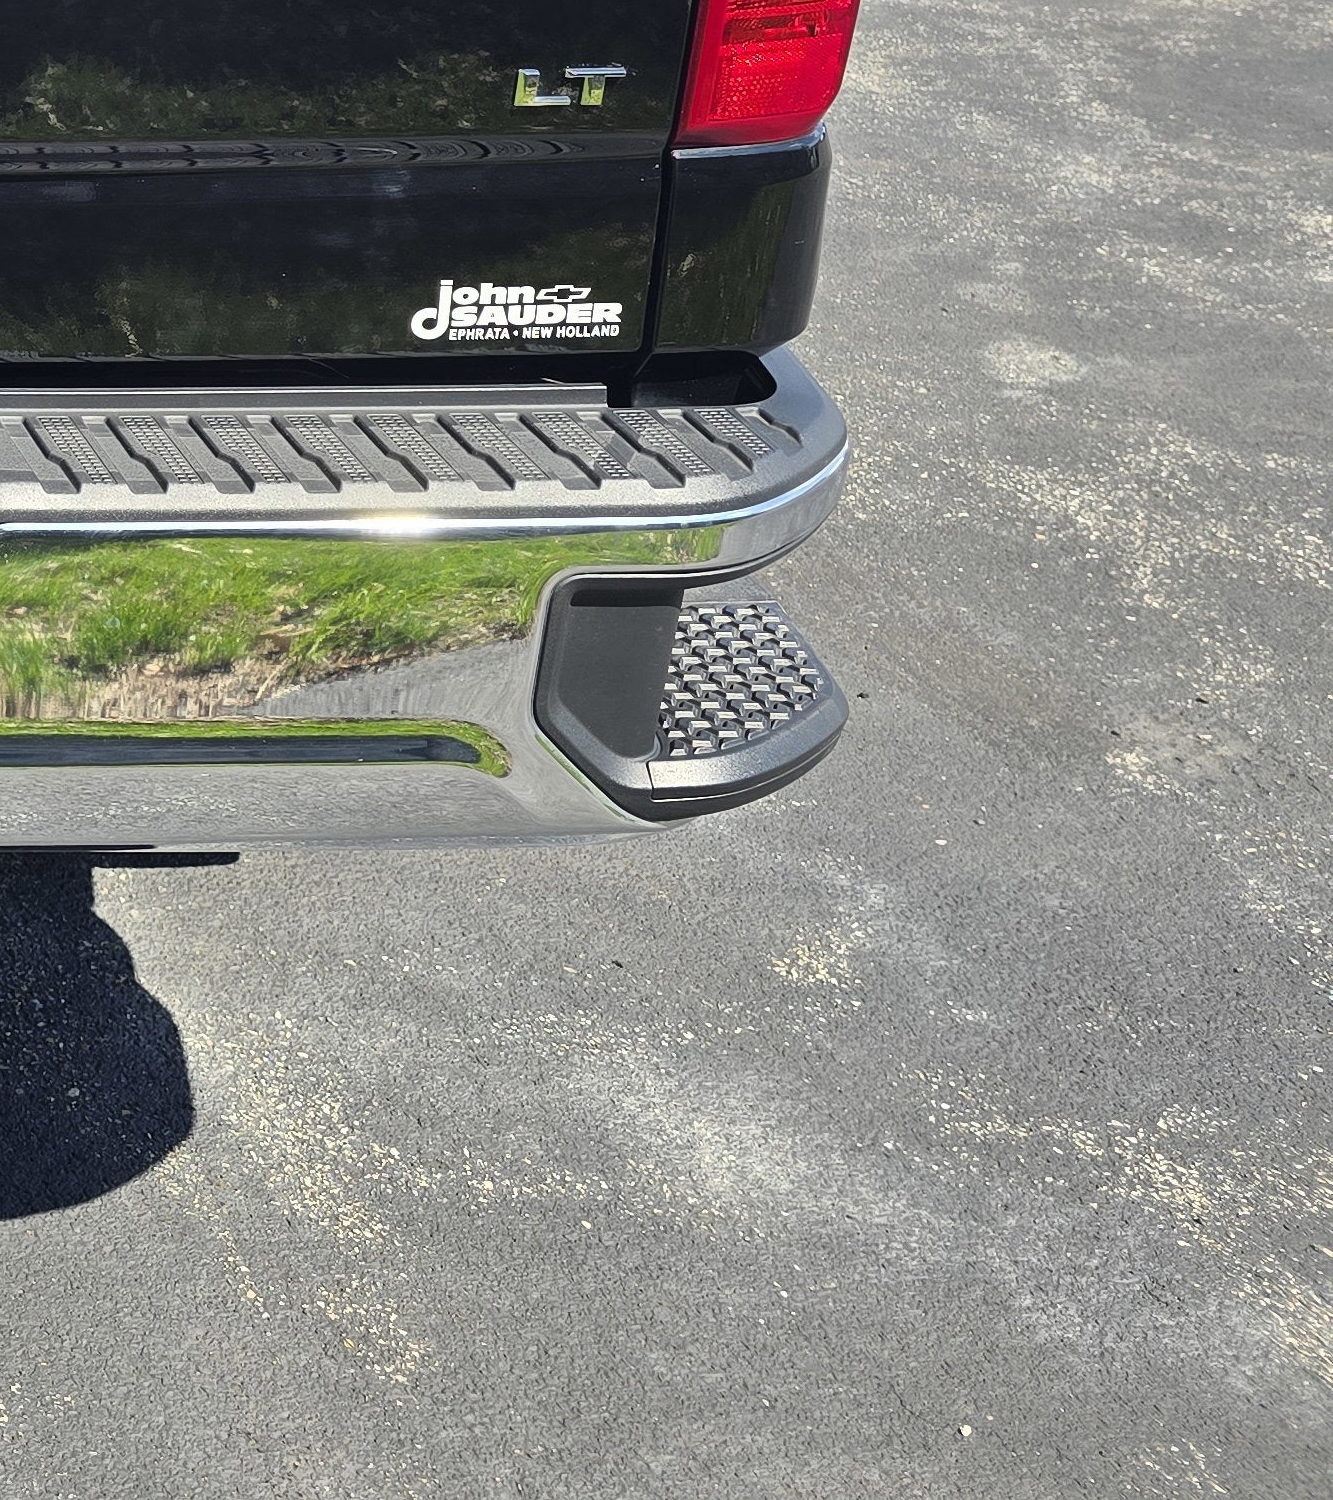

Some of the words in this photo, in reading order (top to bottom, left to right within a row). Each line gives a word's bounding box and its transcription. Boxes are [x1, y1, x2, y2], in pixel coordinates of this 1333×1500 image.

[514, 66, 627, 107] LT
[450, 302, 623, 327] SAUDER
[448, 328, 511, 341] EPHRATA
[522, 326, 554, 339] NEW
[556, 324, 620, 338] HOLLAND
